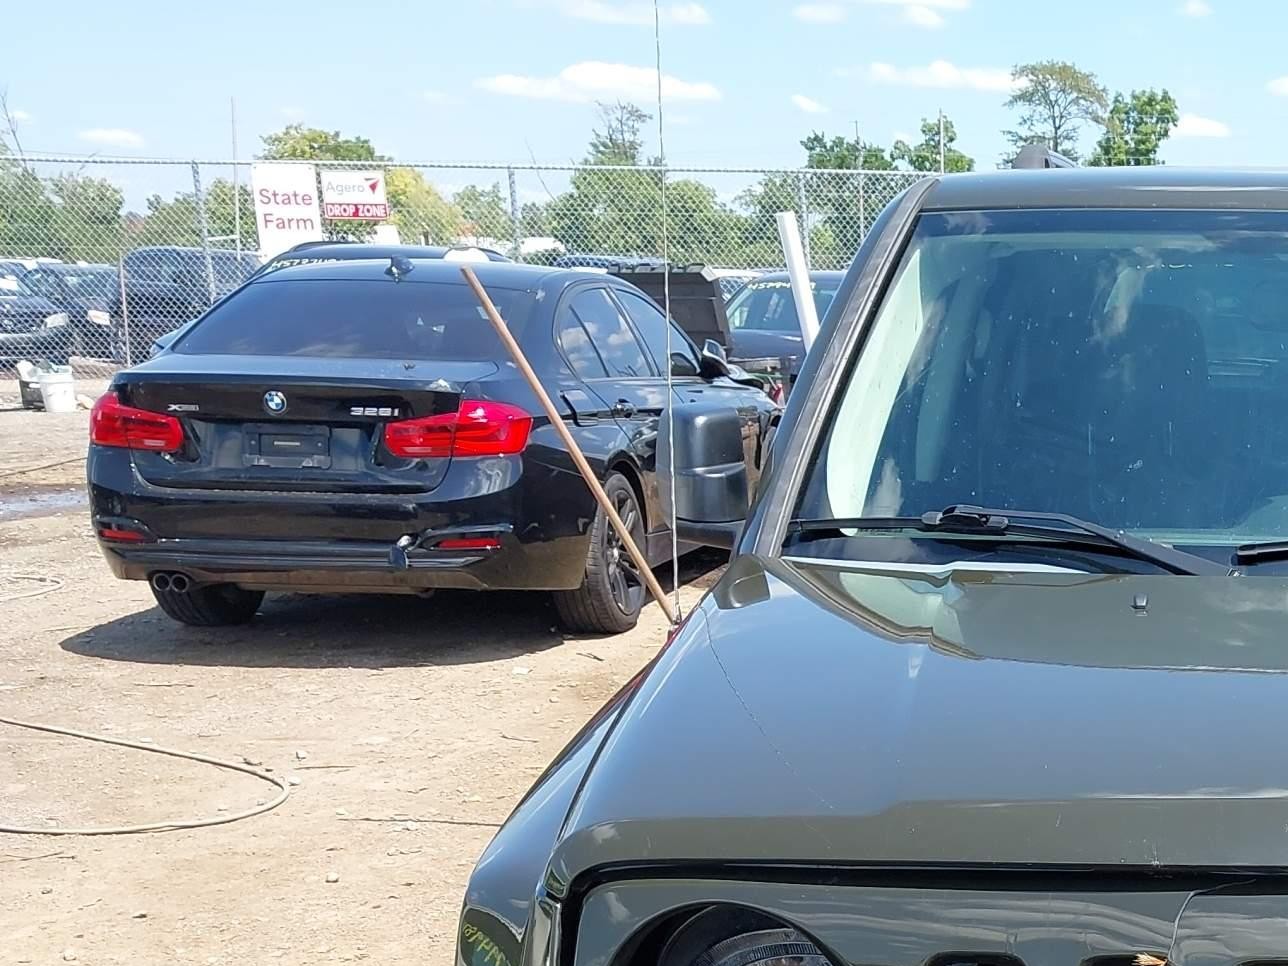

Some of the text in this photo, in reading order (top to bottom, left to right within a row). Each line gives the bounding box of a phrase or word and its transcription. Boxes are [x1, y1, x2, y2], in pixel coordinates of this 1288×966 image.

[325, 181, 366, 195] Agero
[258, 188, 313, 206] State
[327, 204, 387, 217] DROP ZONE
[263, 213, 315, 230] Farm
